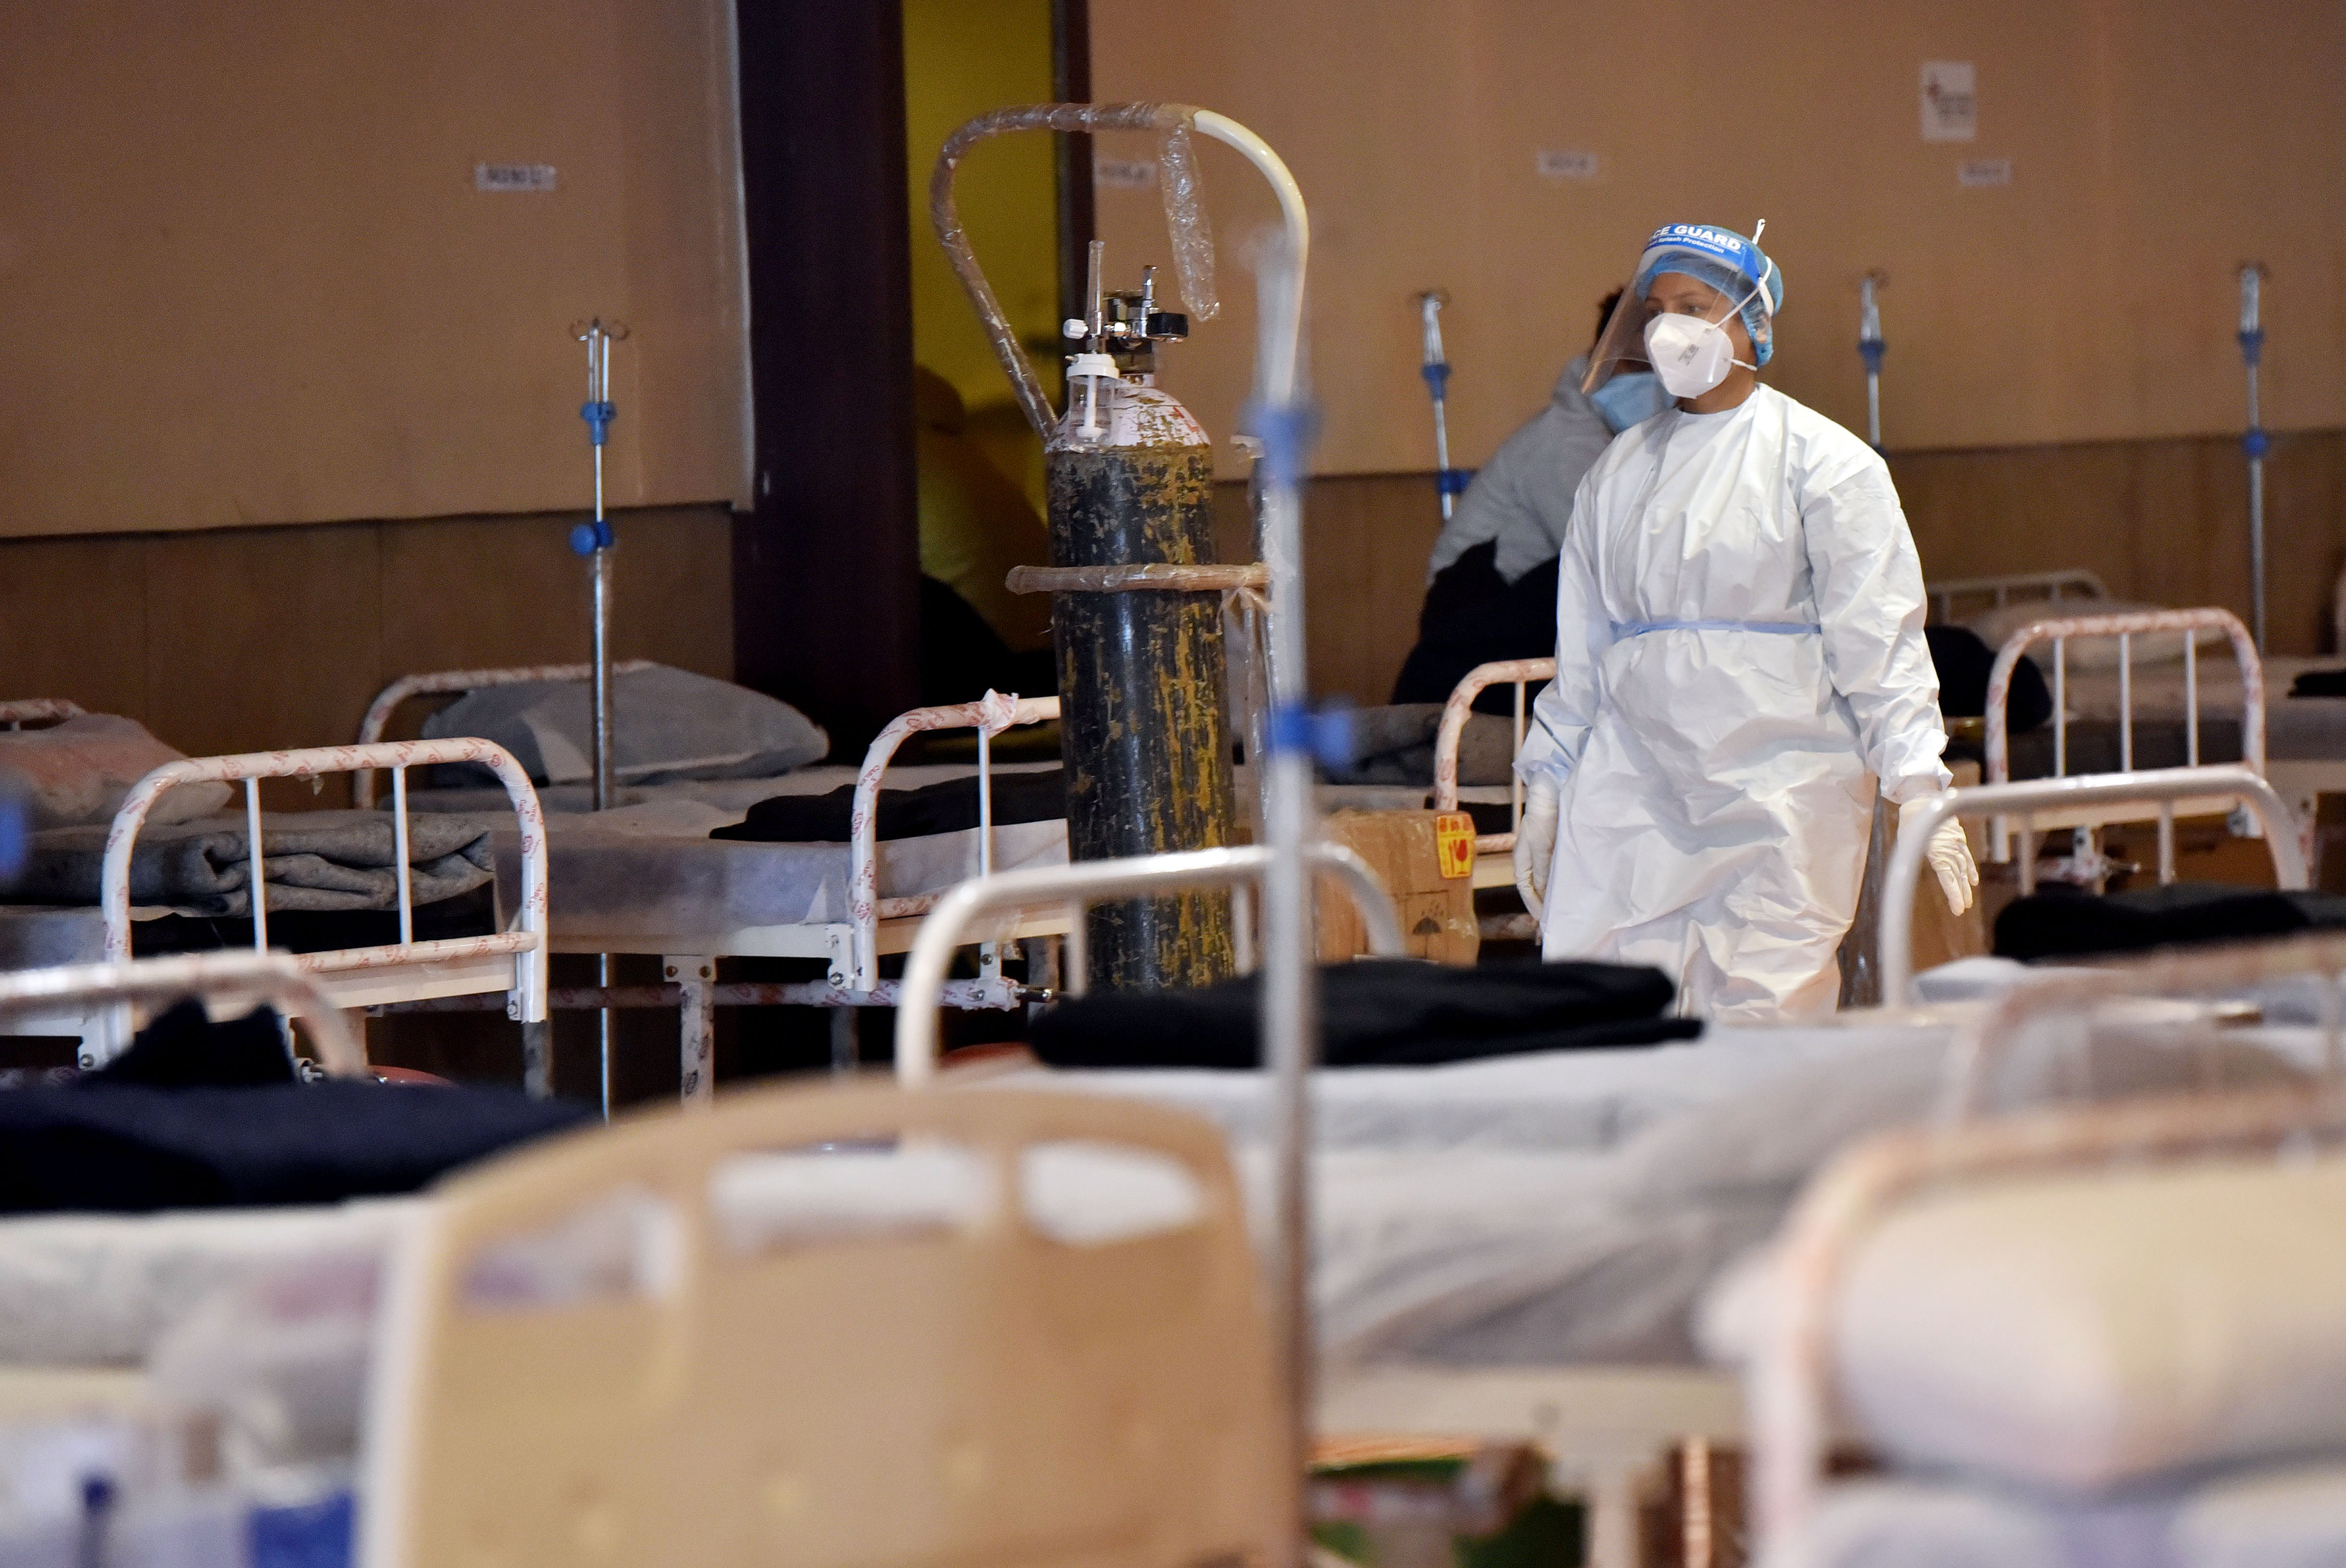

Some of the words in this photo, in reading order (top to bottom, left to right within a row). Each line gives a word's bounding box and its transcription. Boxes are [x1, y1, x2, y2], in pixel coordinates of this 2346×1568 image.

[1652, 225, 1671, 238] CE
[1674, 225, 1741, 250] GUARD
[1683, 237, 1725, 254] Protection
